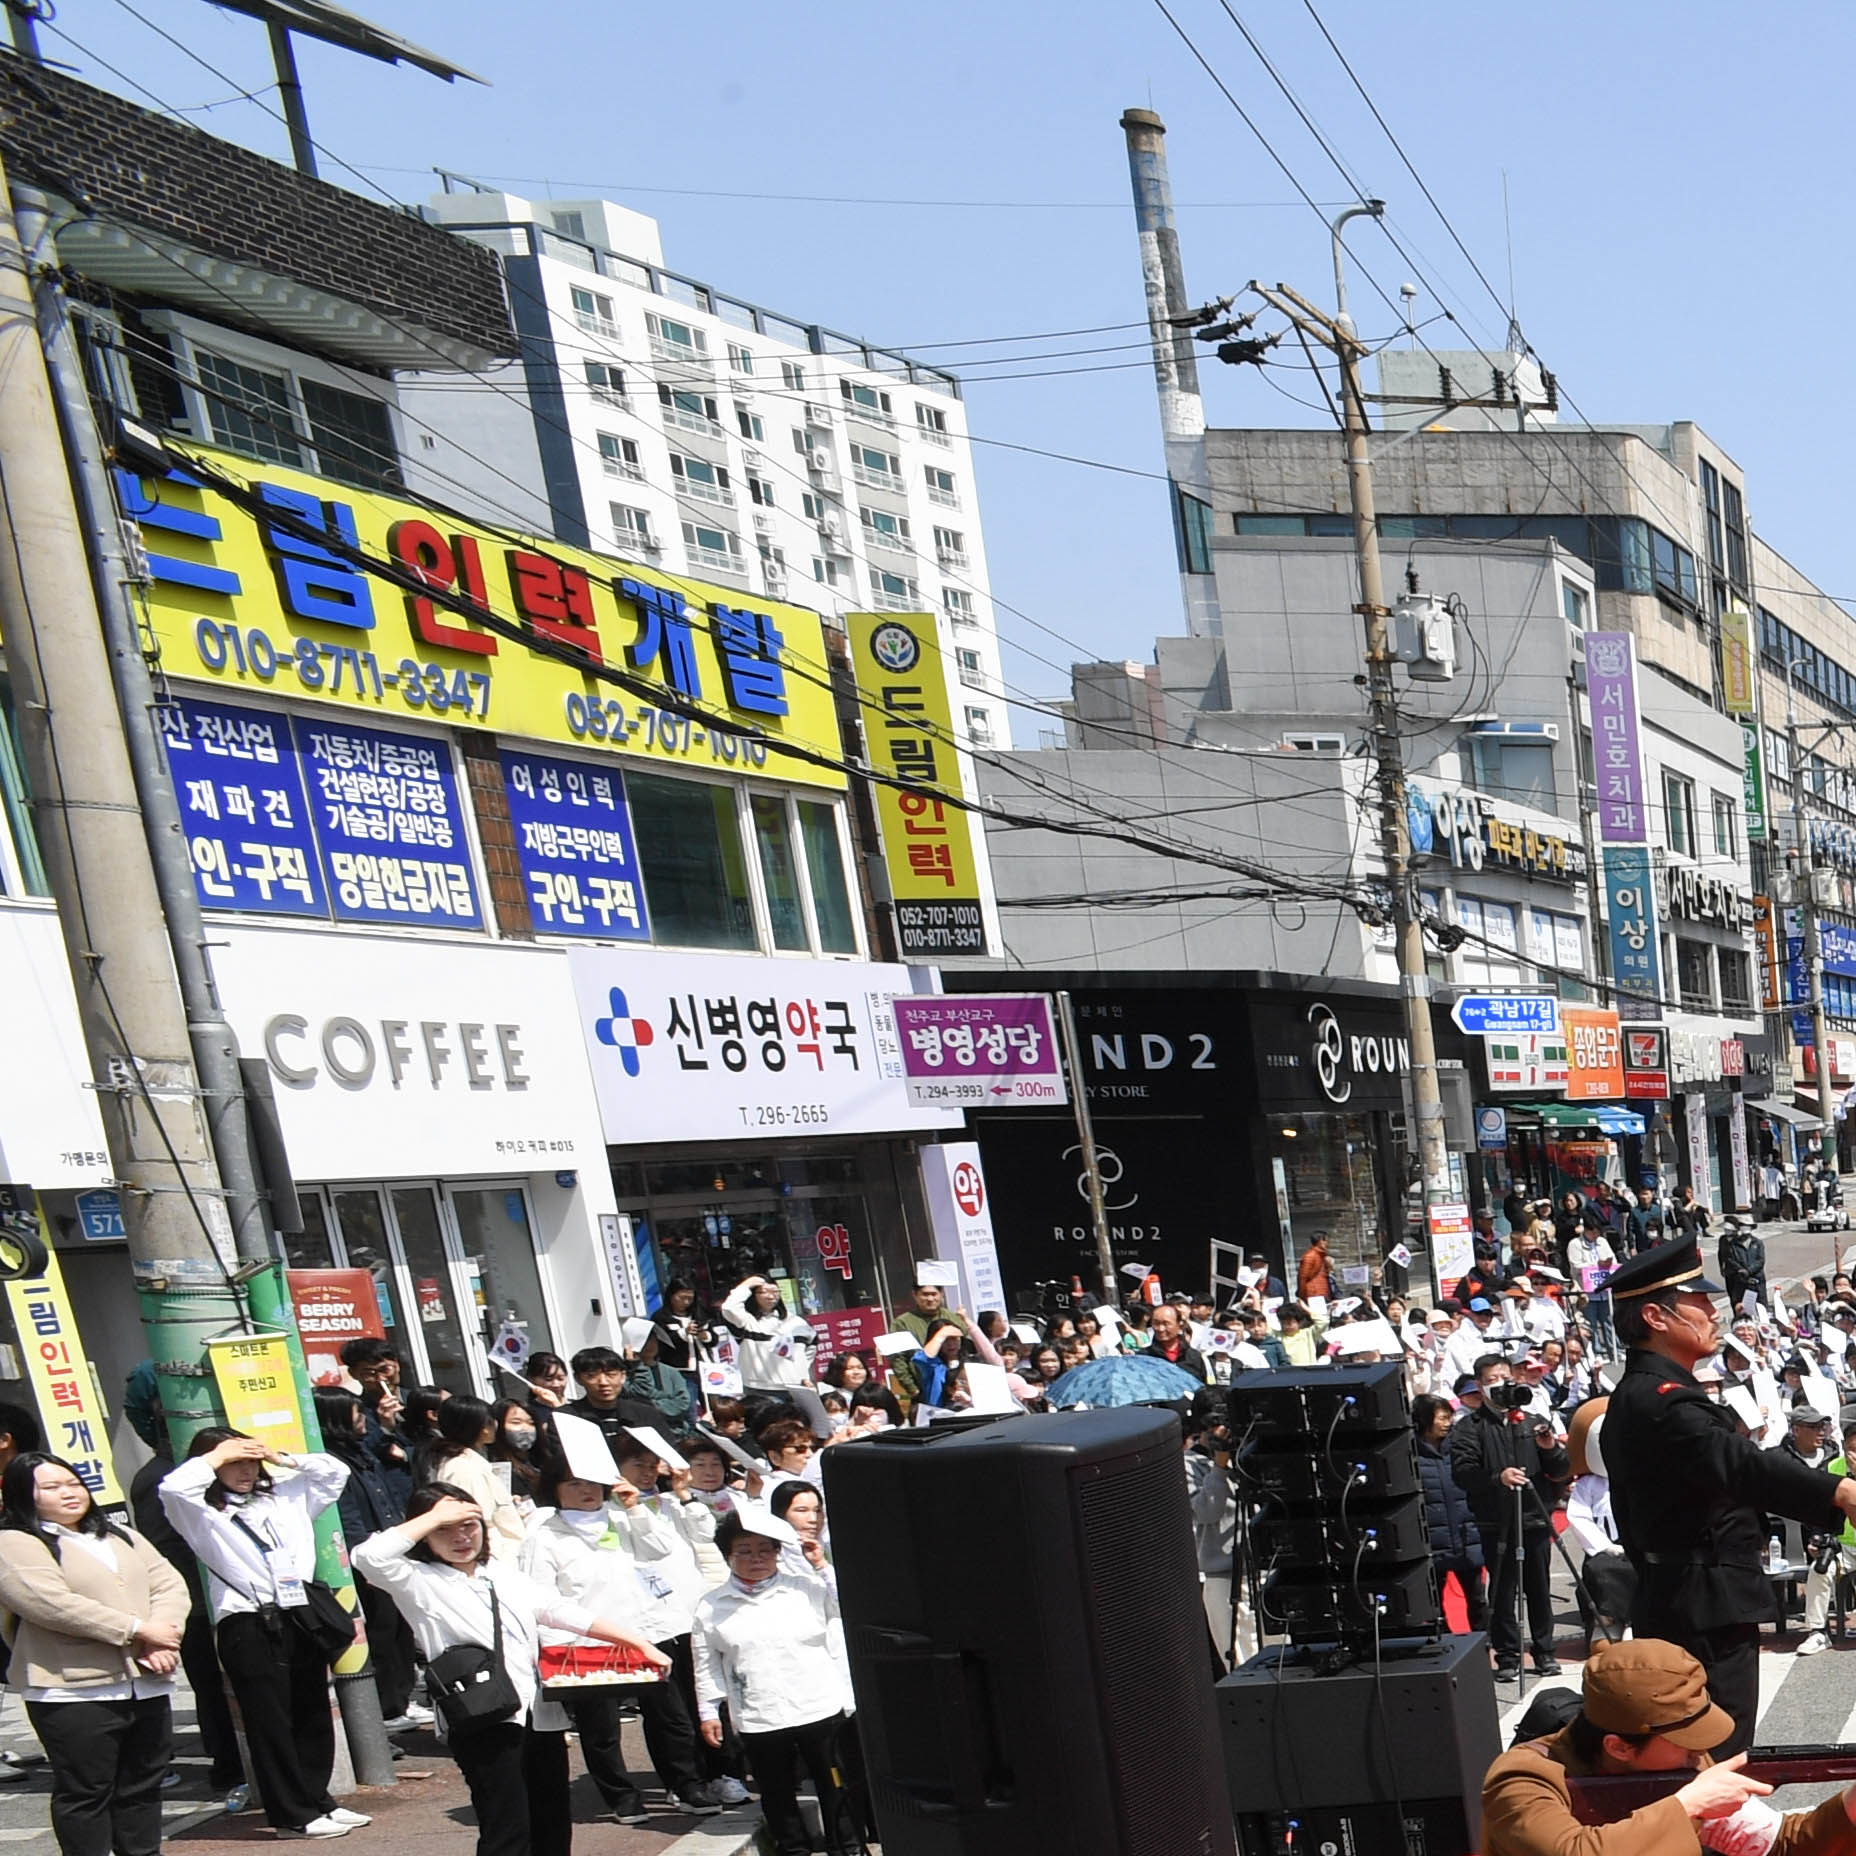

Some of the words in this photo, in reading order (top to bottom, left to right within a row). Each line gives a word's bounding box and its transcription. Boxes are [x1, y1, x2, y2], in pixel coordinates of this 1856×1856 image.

[195, 617, 491, 716] 010-8711-3347
[160, 709, 192, 750] 산
[197, 714, 279, 764] 전산업
[310, 732, 440, 780] 자동차/중공업
[1599, 683, 1637, 833] 서민호치과
[316, 767, 447, 815] 건설현장/공장
[325, 803, 453, 849] 기술공/일반공
[520, 821, 625, 866] 지방근무인력
[186, 835, 315, 905] 인·구직
[329, 852, 475, 917] 당일현금지급
[529, 871, 641, 929] 구인·구직
[900, 905, 980, 927] 052-707-1010
[1615, 885, 1649, 951] 이상
[903, 928, 982, 948] 010-8711-3347
[904, 1008, 944, 1024] 천주교
[946, 1007, 996, 1022] 부산교구
[1488, 999, 1553, 1019] 곽남17길
[264, 1013, 531, 1087] COFFEE
[666, 993, 861, 1073] 신병영약국
[907, 1022, 1042, 1068] 병영성당
[1573, 1026, 1619, 1069] 종합문구
[1015, 1080, 1057, 1098] 300m
[1100, 1084, 1150, 1099] STORE
[955, 1167, 980, 1213] 약
[90, 1214, 126, 1234] 571
[817, 1222, 852, 1281] 약
[298, 1315, 364, 1333] SEASON
[300, 1301, 356, 1319] BERRY
[230, 1342, 270, 1358] 스마트폰
[22, 1285, 107, 1492] 림인력개발
[238, 1376, 277, 1393] 주민신고
